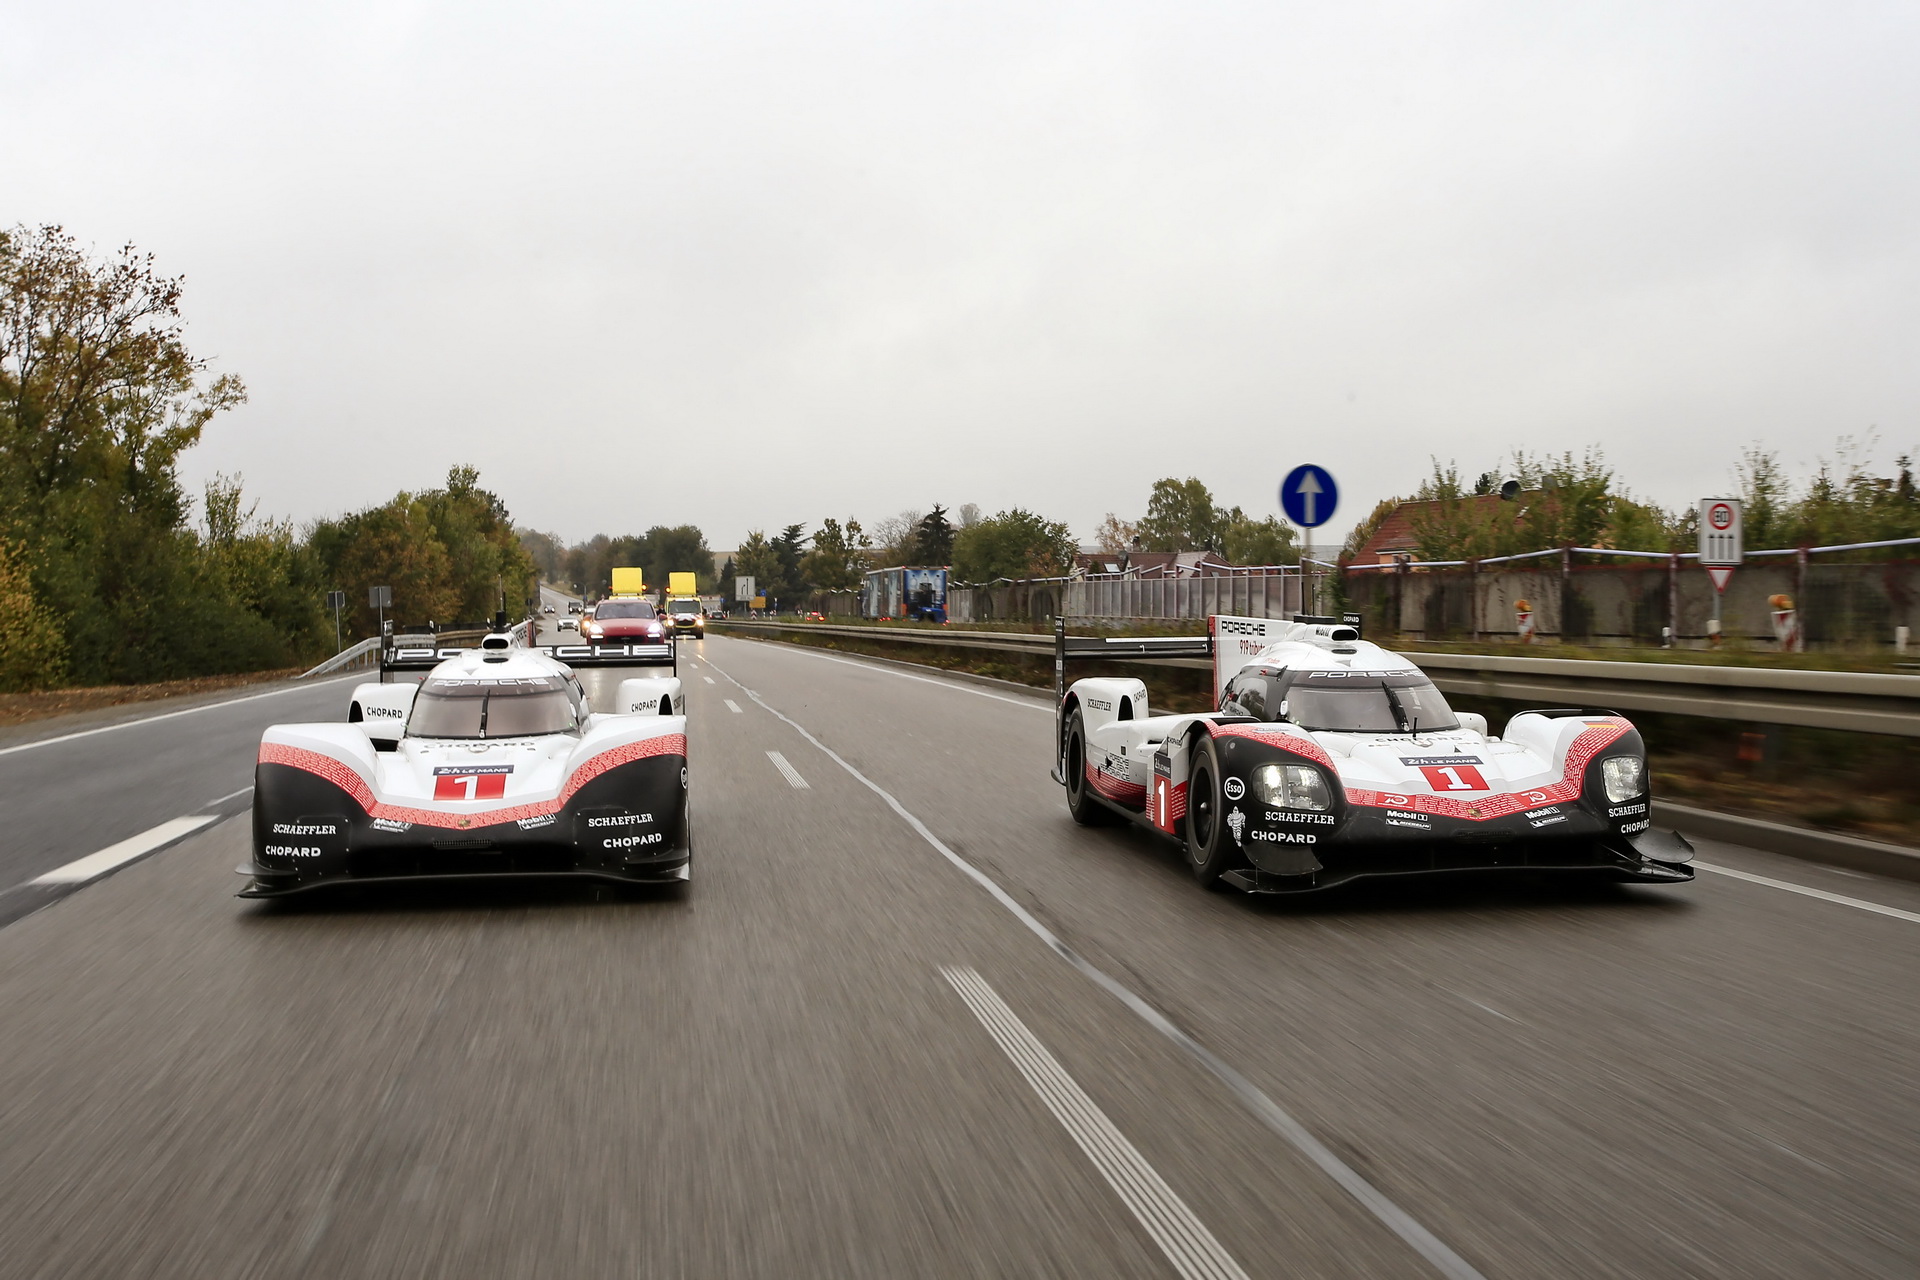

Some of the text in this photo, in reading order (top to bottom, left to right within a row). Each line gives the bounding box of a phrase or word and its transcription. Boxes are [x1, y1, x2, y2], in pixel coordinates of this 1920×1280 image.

[1222, 621, 1266, 636] PORSCHE
[1239, 640, 1249, 655] 919
[431, 679, 550, 687] PORSCHE
[631, 699, 658, 713] CHOPARD
[1087, 698, 1112, 712] SCHAEFFLER
[366, 707, 403, 719] CHOPARD
[1437, 767, 1473, 789] 1
[453, 775, 479, 800] 1
[1158, 780, 1165, 827] 1
[1608, 803, 1646, 817] SCHAEFFLER
[516, 814, 546, 825] Mobil
[588, 813, 653, 828] SCHAEFFLER
[1265, 811, 1335, 825] SCHAEFFLER
[1387, 810, 1417, 820] Mobil
[1525, 808, 1551, 819] Mobil
[273, 823, 337, 836] SCHAEFFLER
[603, 833, 663, 849] CHOPARD
[1251, 830, 1317, 844] CHOPARD
[265, 845, 322, 858] CHOPARD
